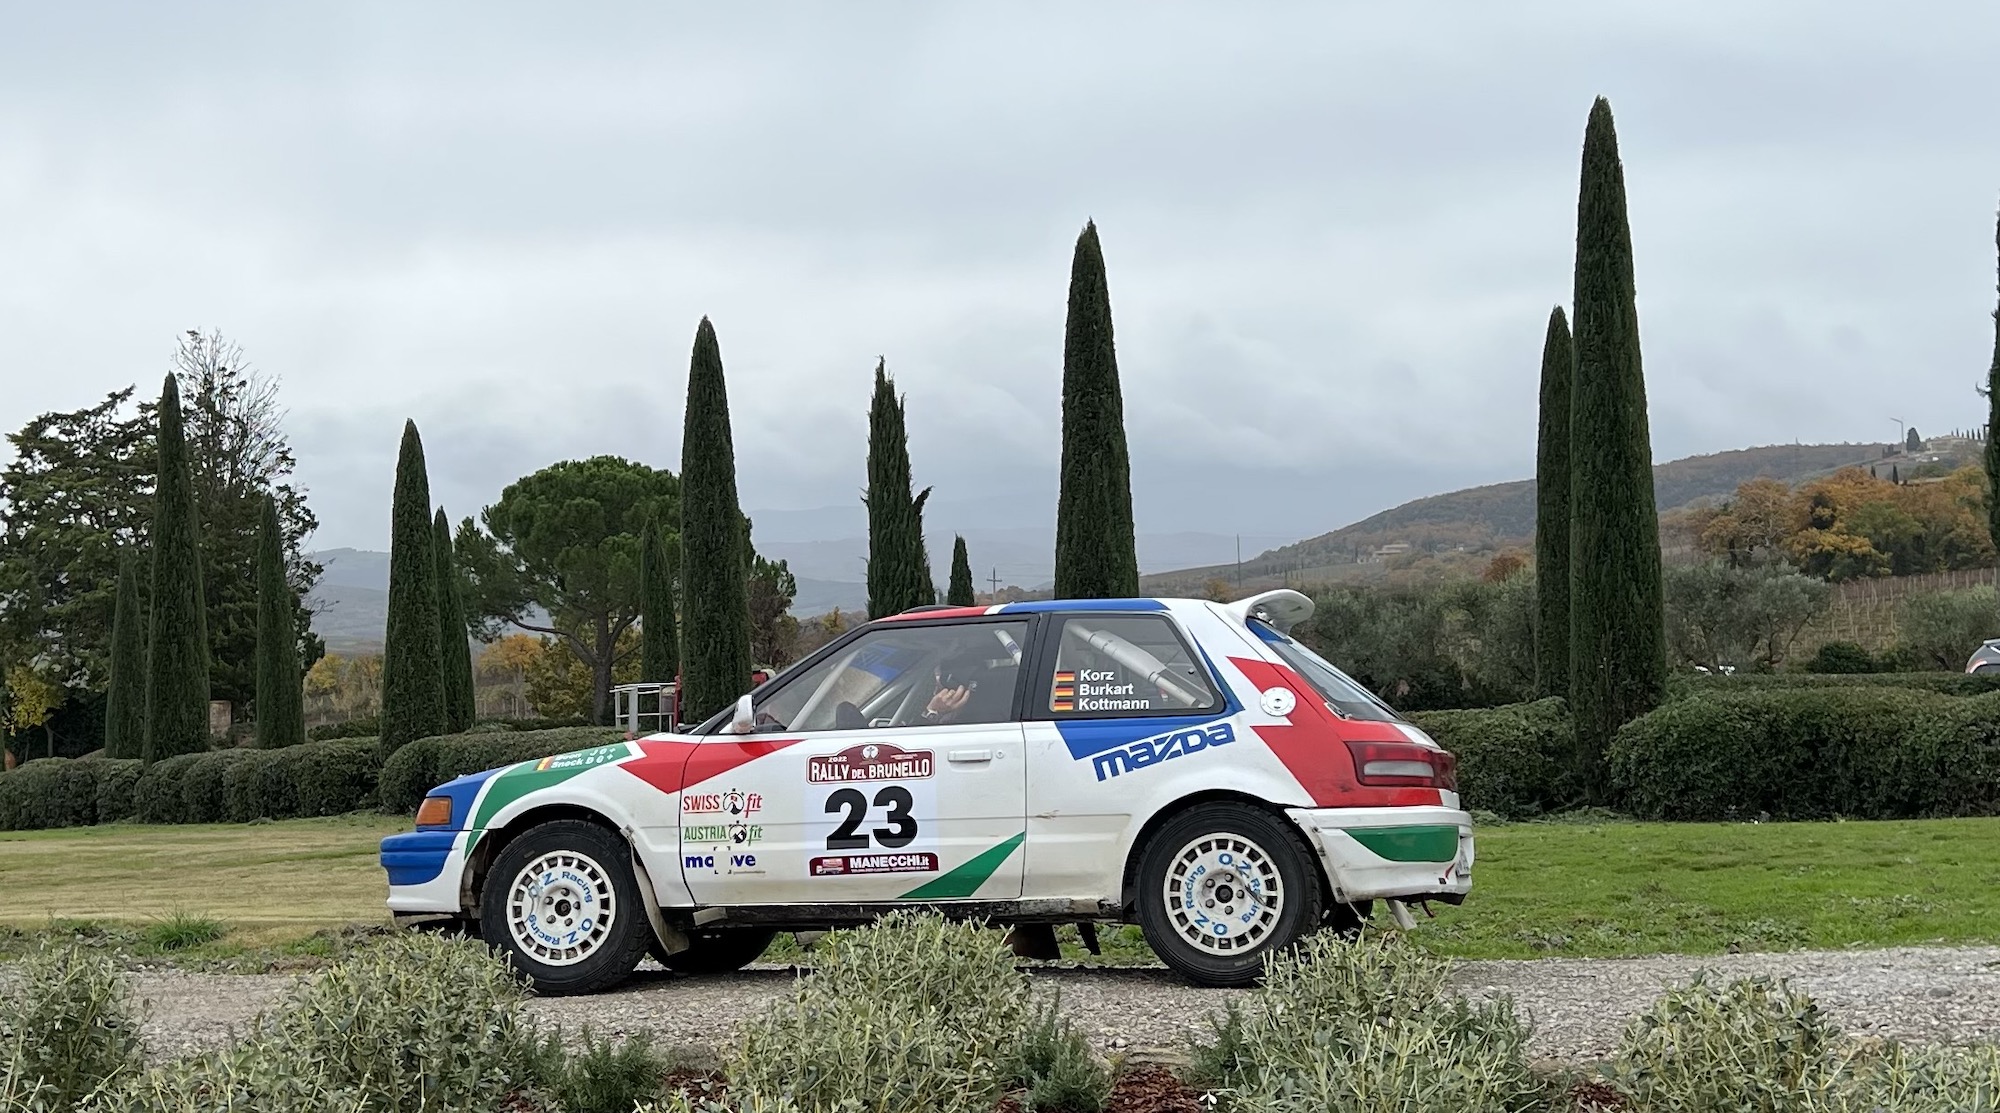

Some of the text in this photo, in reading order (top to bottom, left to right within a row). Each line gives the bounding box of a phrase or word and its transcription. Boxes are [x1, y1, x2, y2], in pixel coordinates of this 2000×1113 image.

[1080, 669, 1115, 682] Korz
[1080, 683, 1134, 696] Burkart
[1078, 698, 1150, 711] Kottmann
[811, 762, 850, 781] RALLY
[868, 759, 931, 778] BRUNELLO
[683, 793, 763, 818] SWISS fit
[825, 785, 918, 851] 23
[683, 825, 763, 847] AUSTRIA fit
[849, 855, 930, 868] MANECCHI.it
[562, 871, 594, 904] Racing
[1185, 865, 1206, 909] Racing
[528, 914, 560, 946] Racing
